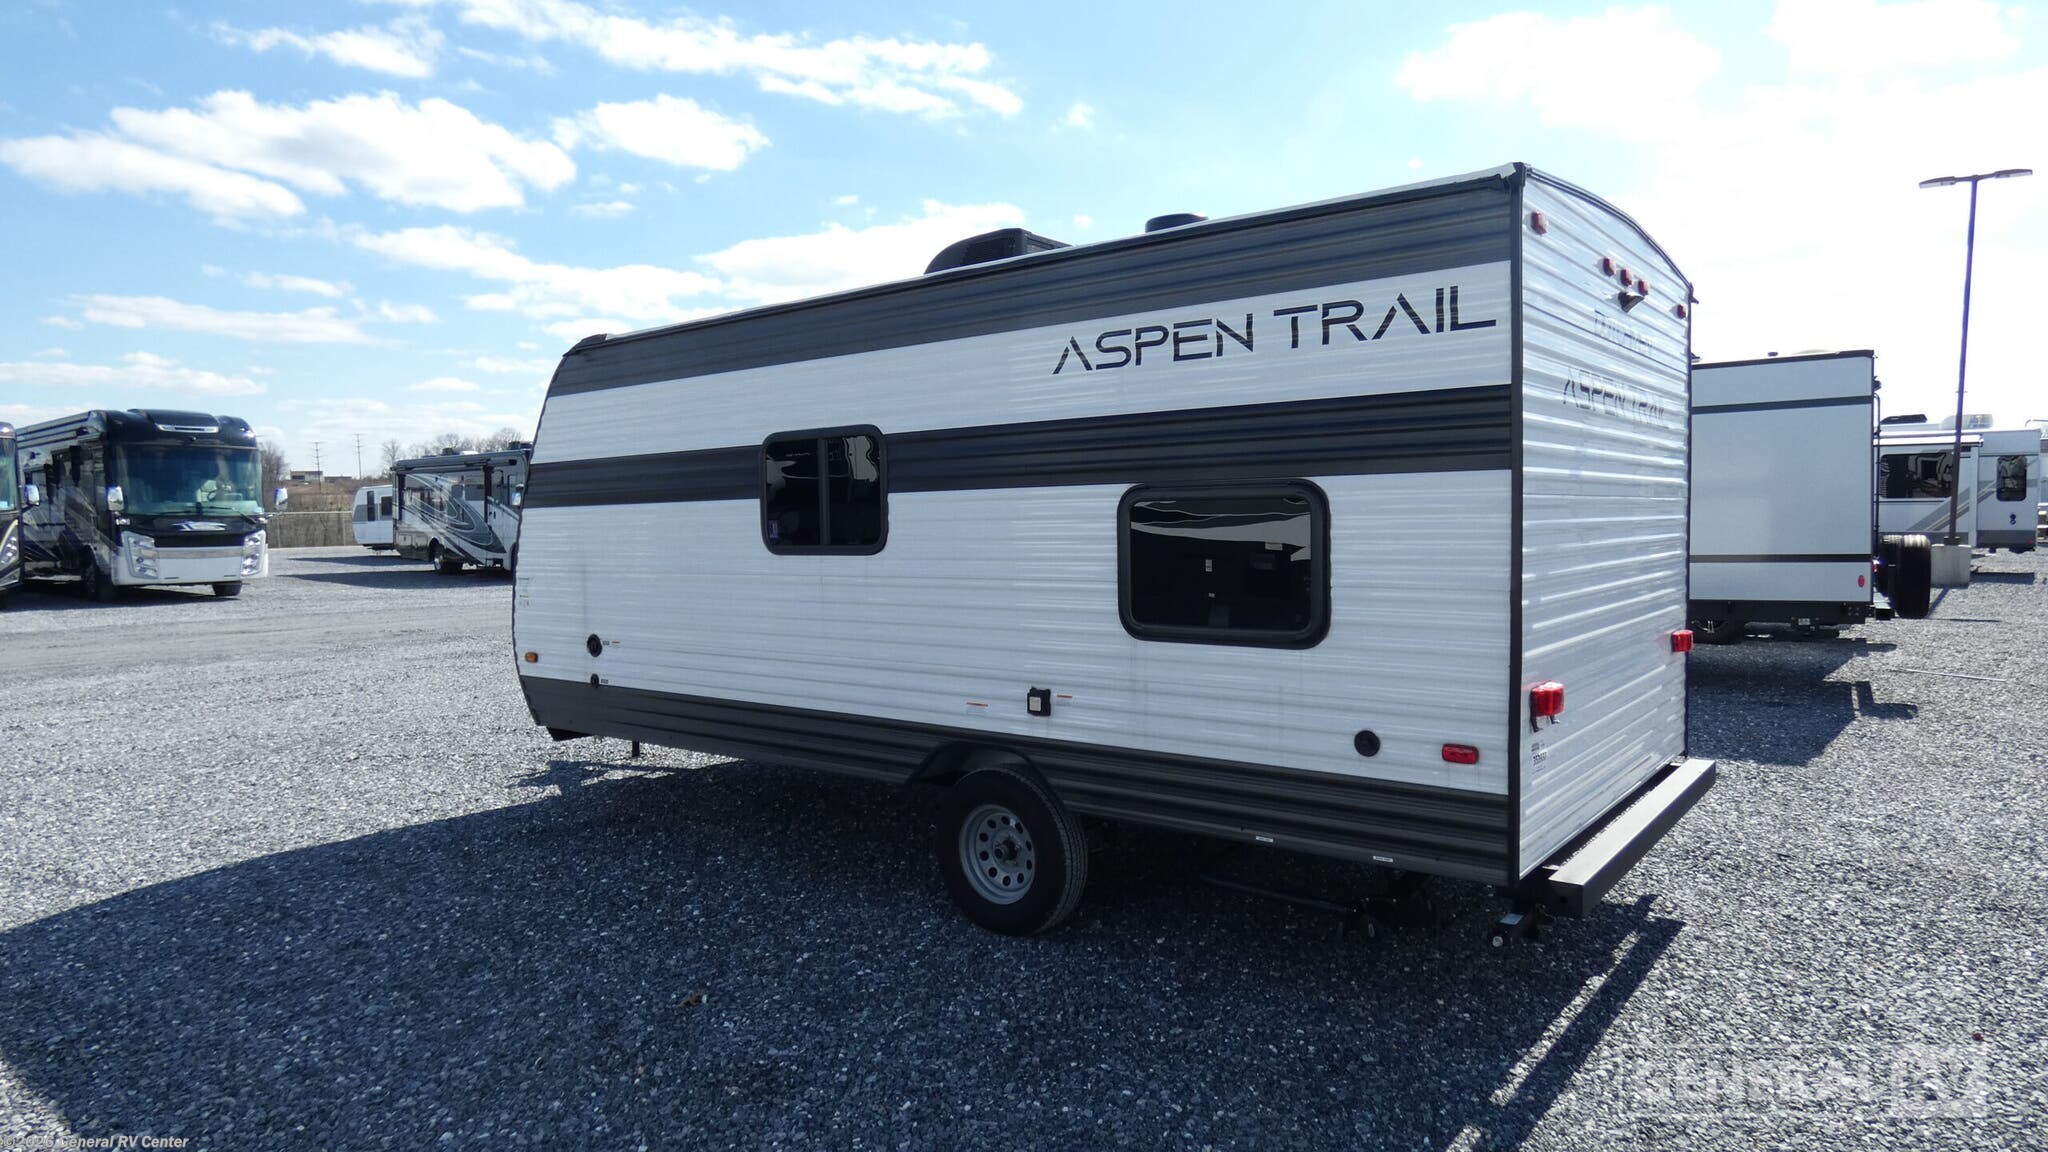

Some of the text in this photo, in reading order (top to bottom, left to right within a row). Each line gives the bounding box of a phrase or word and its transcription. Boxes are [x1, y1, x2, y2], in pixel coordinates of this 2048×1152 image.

[1052, 285, 1497, 375] ASPEN TRAIL
[1562, 367, 1626, 417] ASPEN
